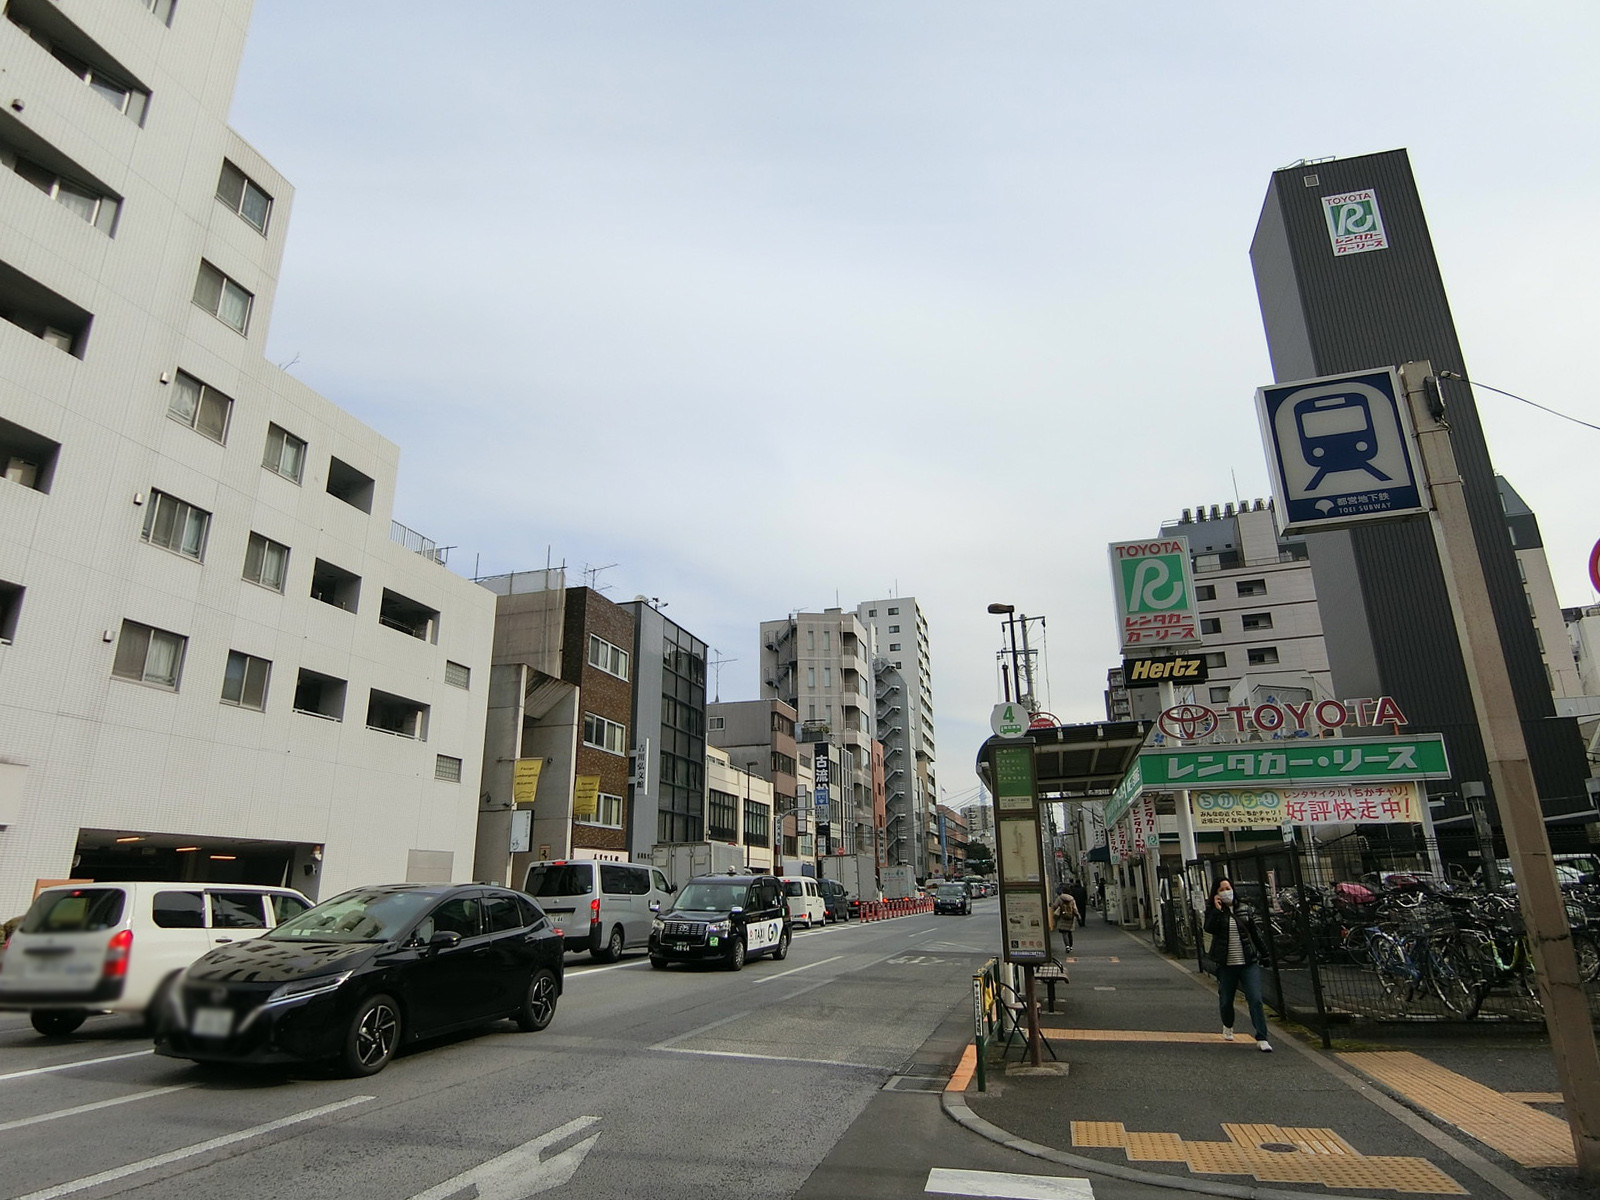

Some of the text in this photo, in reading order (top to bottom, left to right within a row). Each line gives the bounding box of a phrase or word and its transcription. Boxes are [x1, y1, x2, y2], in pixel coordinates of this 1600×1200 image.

[1325, 192, 1372, 206] TOYOTA
[1335, 233, 1381, 245] レンタカー
[1337, 240, 1383, 253] カーリース
[1336, 491, 1391, 506] 都営地下鉄
[1338, 502, 1392, 514] TOEI SUBWAY
[1115, 541, 1183, 558] TOYOTA
[1125, 613, 1193, 628] レンタカー
[1126, 627, 1196, 643] カーリース
[1131, 657, 1200, 680] Hertz
[1003, 705, 1015, 723] 4
[1225, 696, 1409, 733] TOYOTA
[1167, 746, 1418, 779] レンタカー・リース
[1143, 798, 1155, 832] レンタカー
[1284, 797, 1410, 821] 好評快走中!
